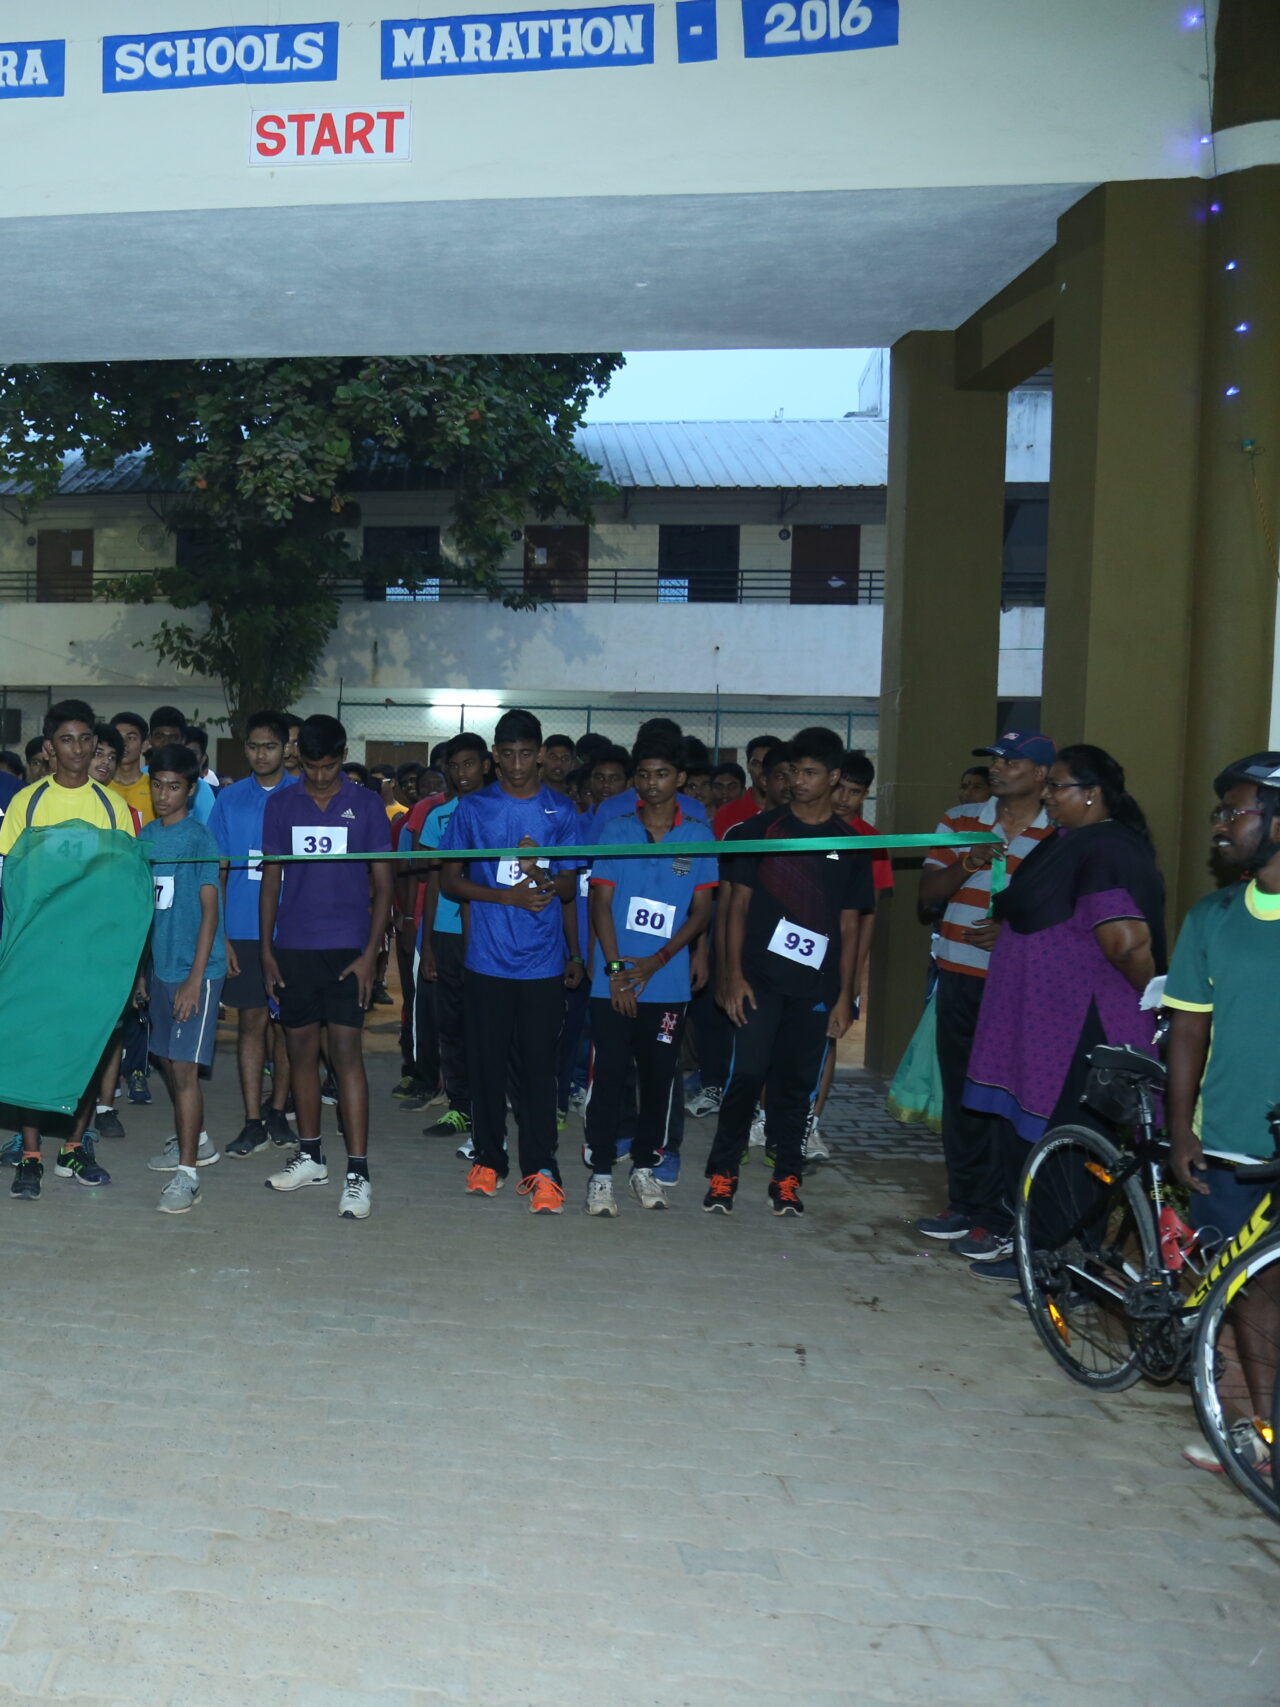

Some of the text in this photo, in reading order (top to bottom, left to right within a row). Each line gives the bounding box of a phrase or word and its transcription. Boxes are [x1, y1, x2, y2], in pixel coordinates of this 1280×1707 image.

[114, 31, 324, 82] SCHOOLS
[392, 14, 645, 68] MARATHON
[764, 0, 873, 45] 2016
[255, 111, 405, 157] START
[303, 835, 332, 853] 39
[634, 908, 665, 930] 80
[784, 932, 816, 956] 93
